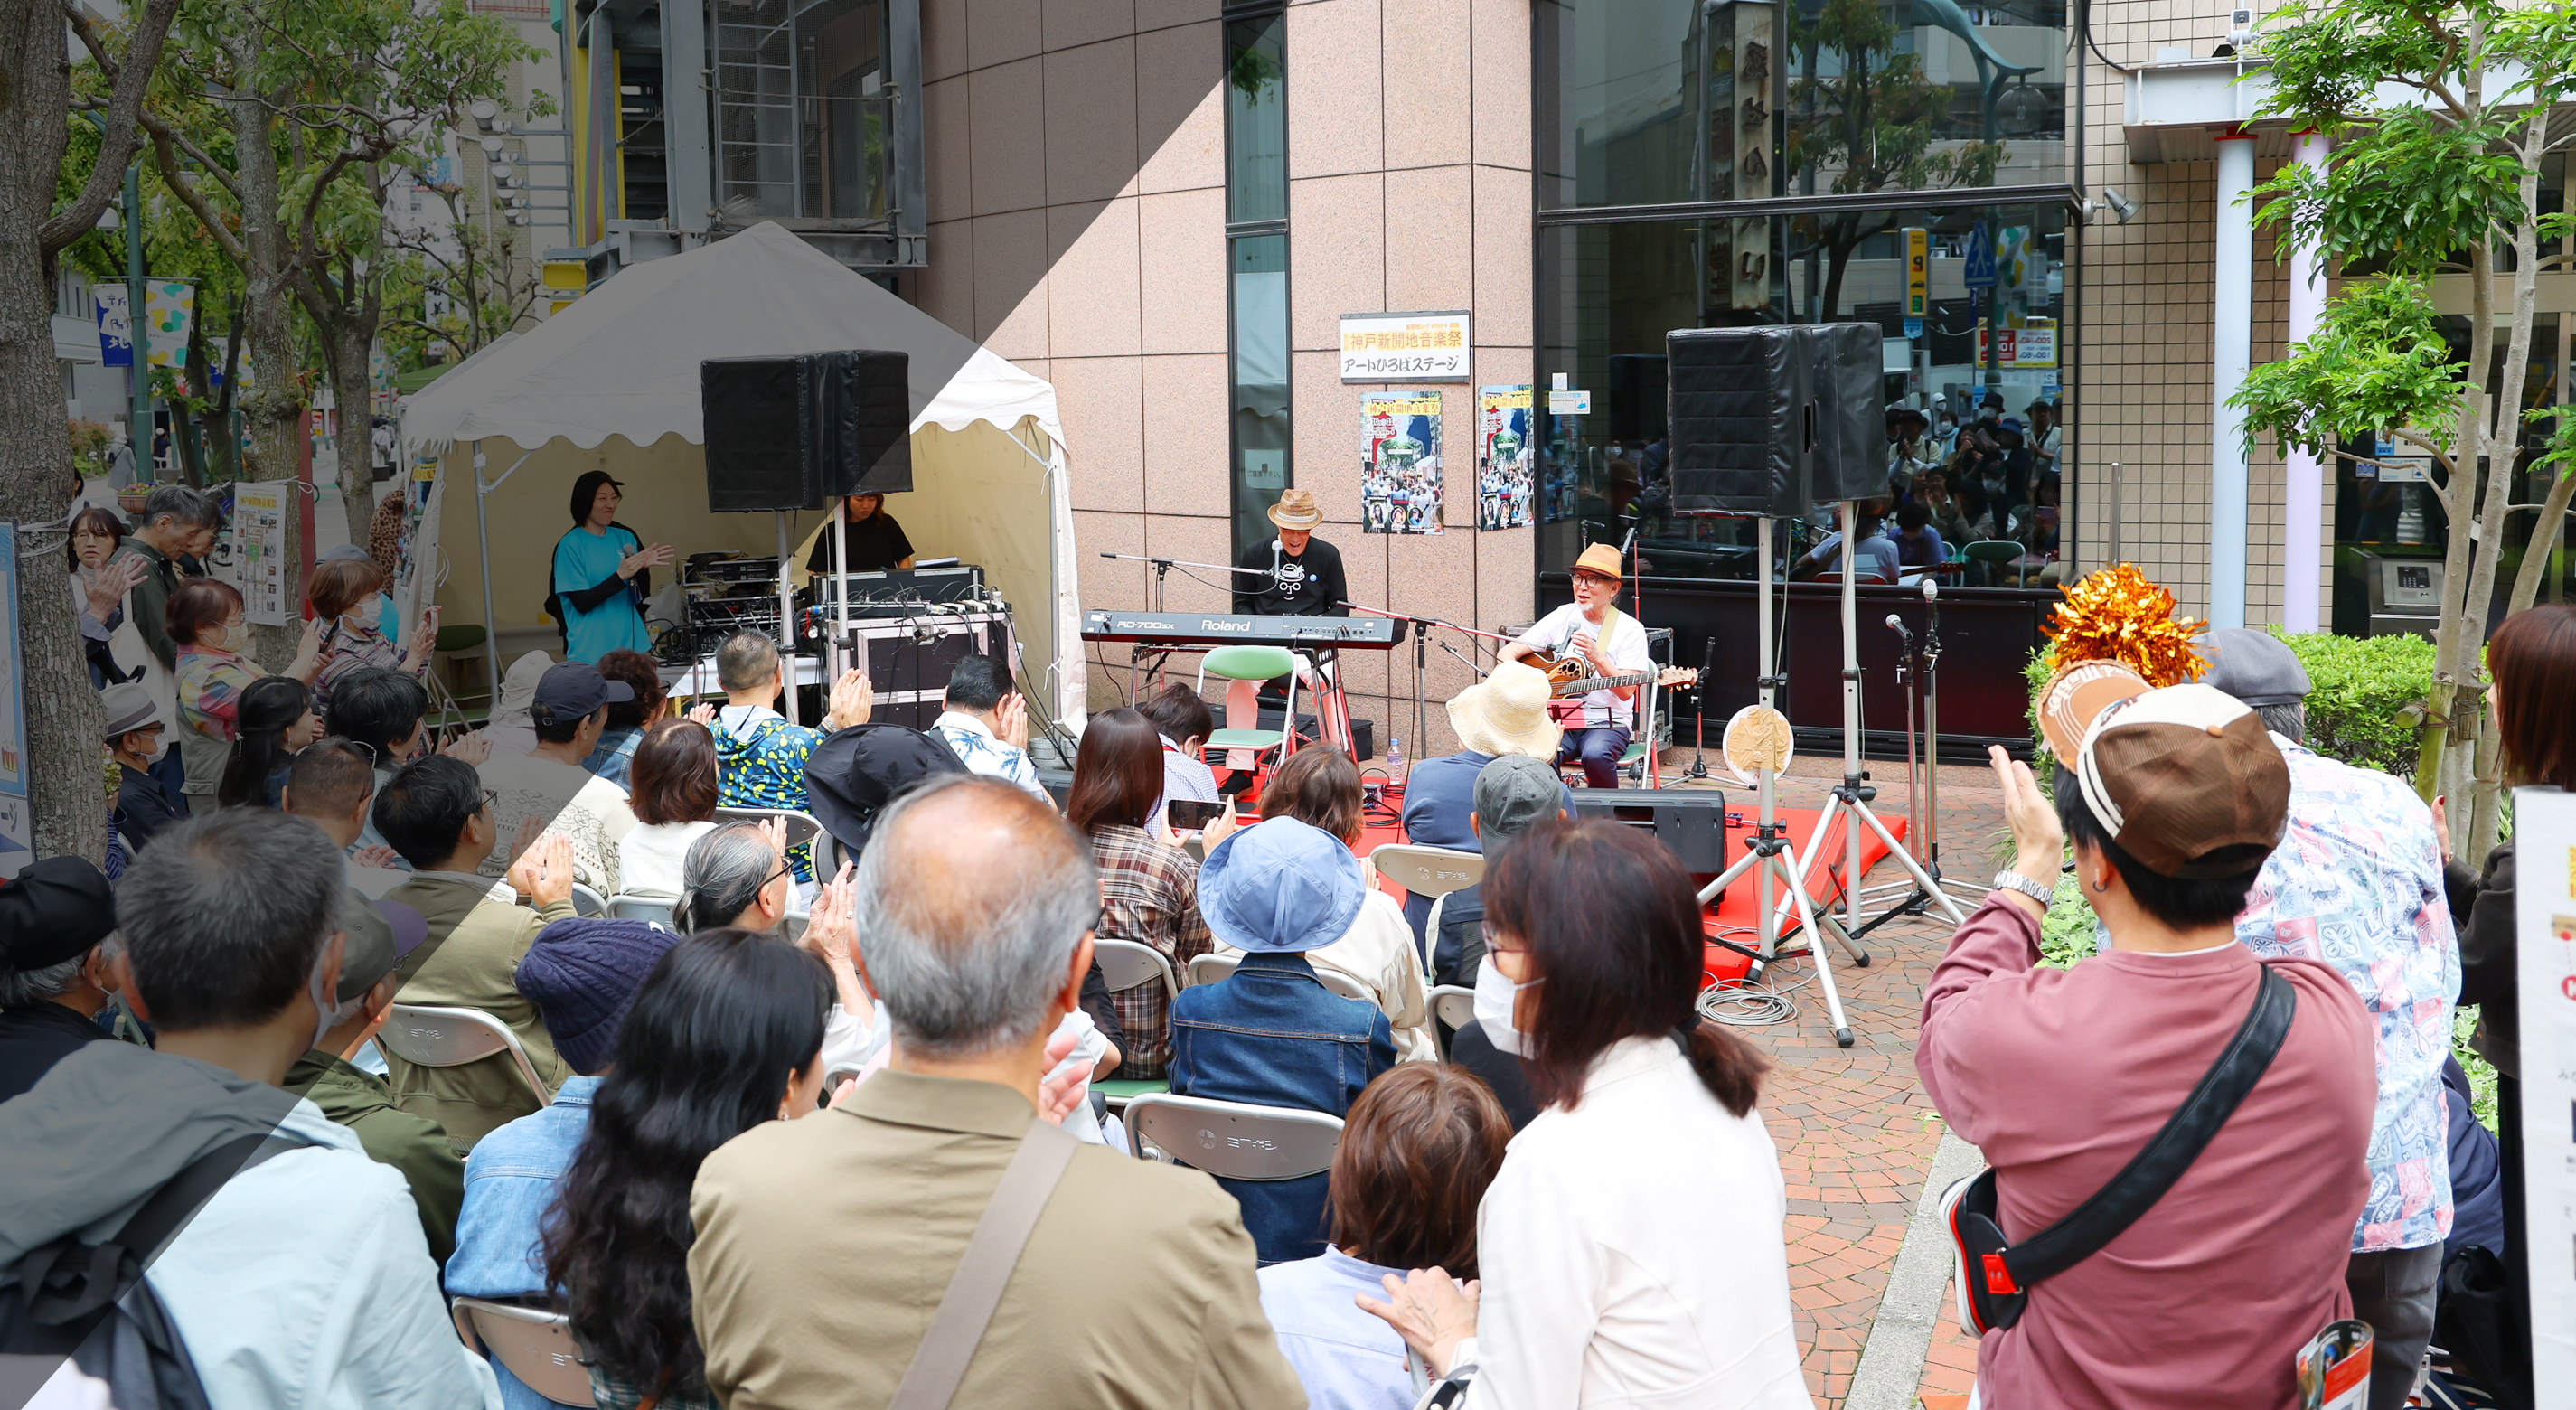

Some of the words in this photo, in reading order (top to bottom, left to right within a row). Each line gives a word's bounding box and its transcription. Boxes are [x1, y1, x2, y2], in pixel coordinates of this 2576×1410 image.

[1350, 331, 1462, 350] 神戸新開地音楽祭
[1345, 355, 1459, 372] アートひろばステージ
[1200, 619, 1251, 632] Roland
